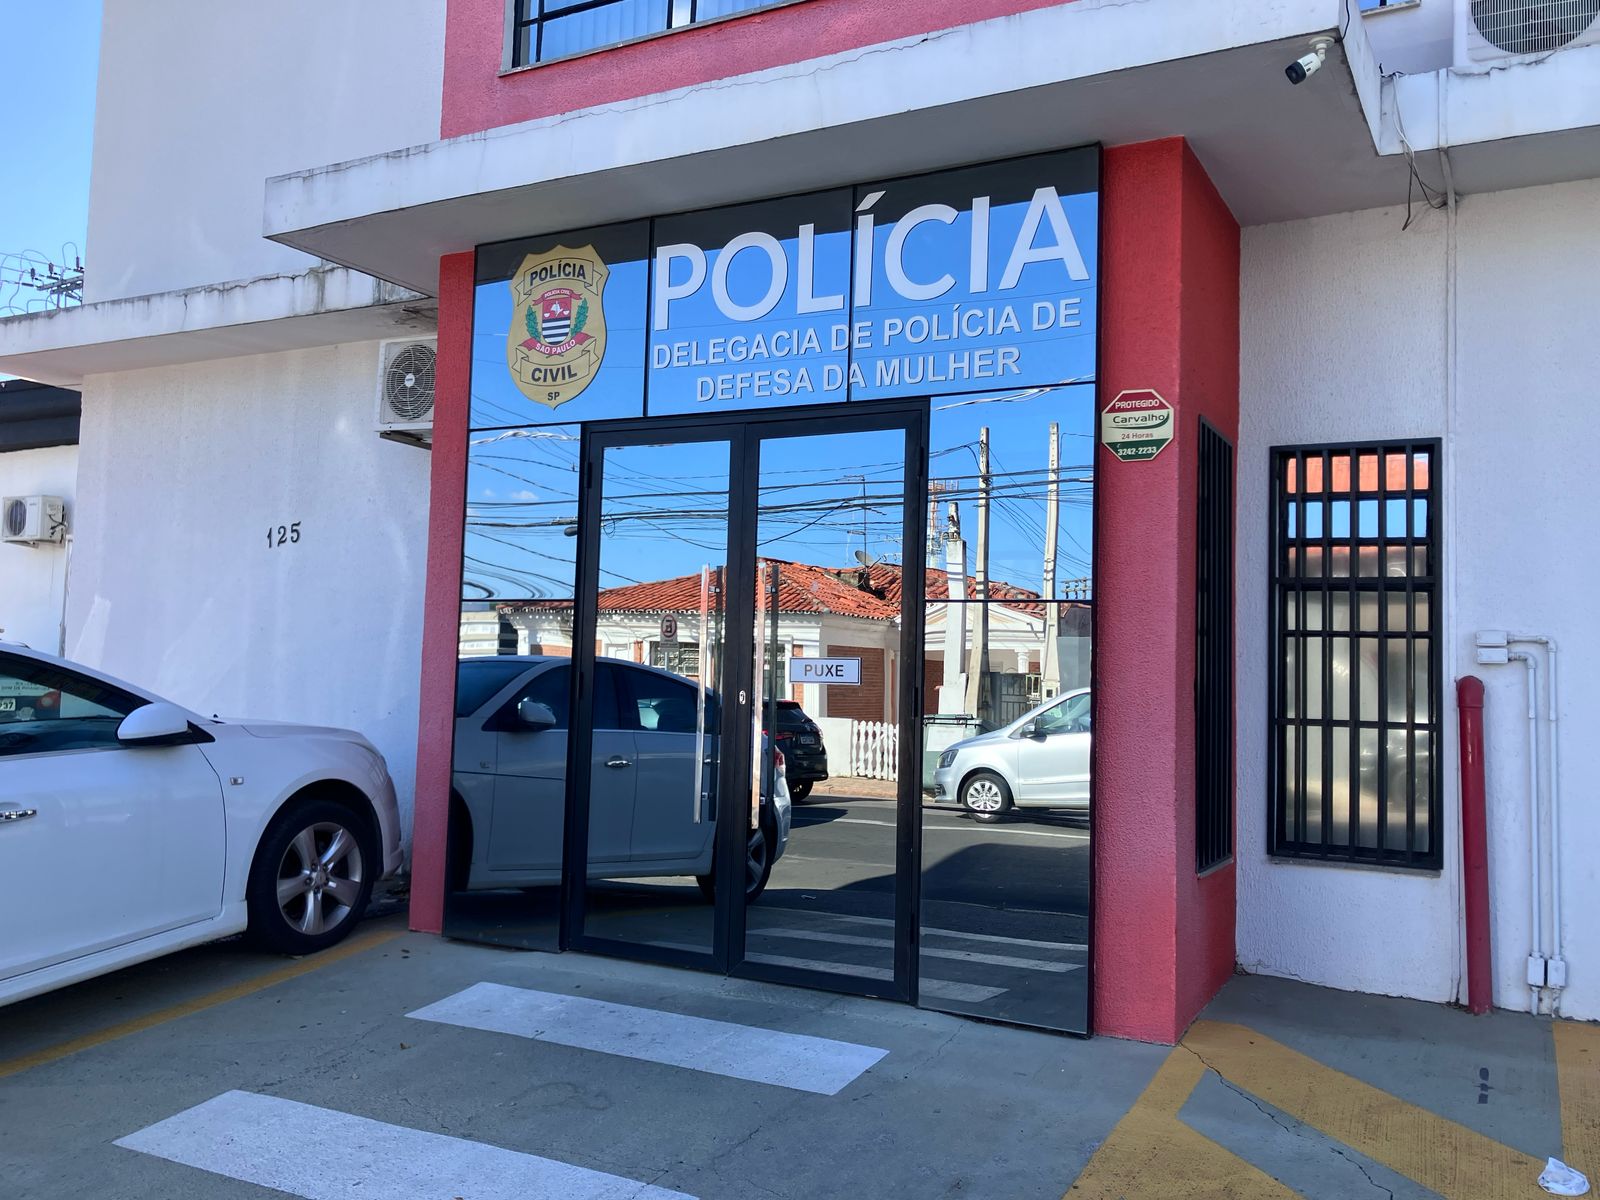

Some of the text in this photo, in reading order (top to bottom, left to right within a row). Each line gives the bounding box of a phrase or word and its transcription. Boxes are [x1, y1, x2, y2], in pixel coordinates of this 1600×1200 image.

[654, 186, 1090, 330] POLÍCIA
[530, 261, 586, 287] POLÍCIA
[654, 298, 1081, 369] DELEGACIA DE POLÍCIA DE
[552, 339, 576, 354] PAULO
[531, 364, 577, 382] CIVIL
[697, 347, 1021, 402] DEFESA DA MULHER
[547, 391, 560, 401] SP
[1115, 399, 1159, 409] PROTEGIDO
[1113, 414, 1165, 424] Carvalho
[267, 521, 301, 548] 125
[804, 664, 844, 677] PUXE
